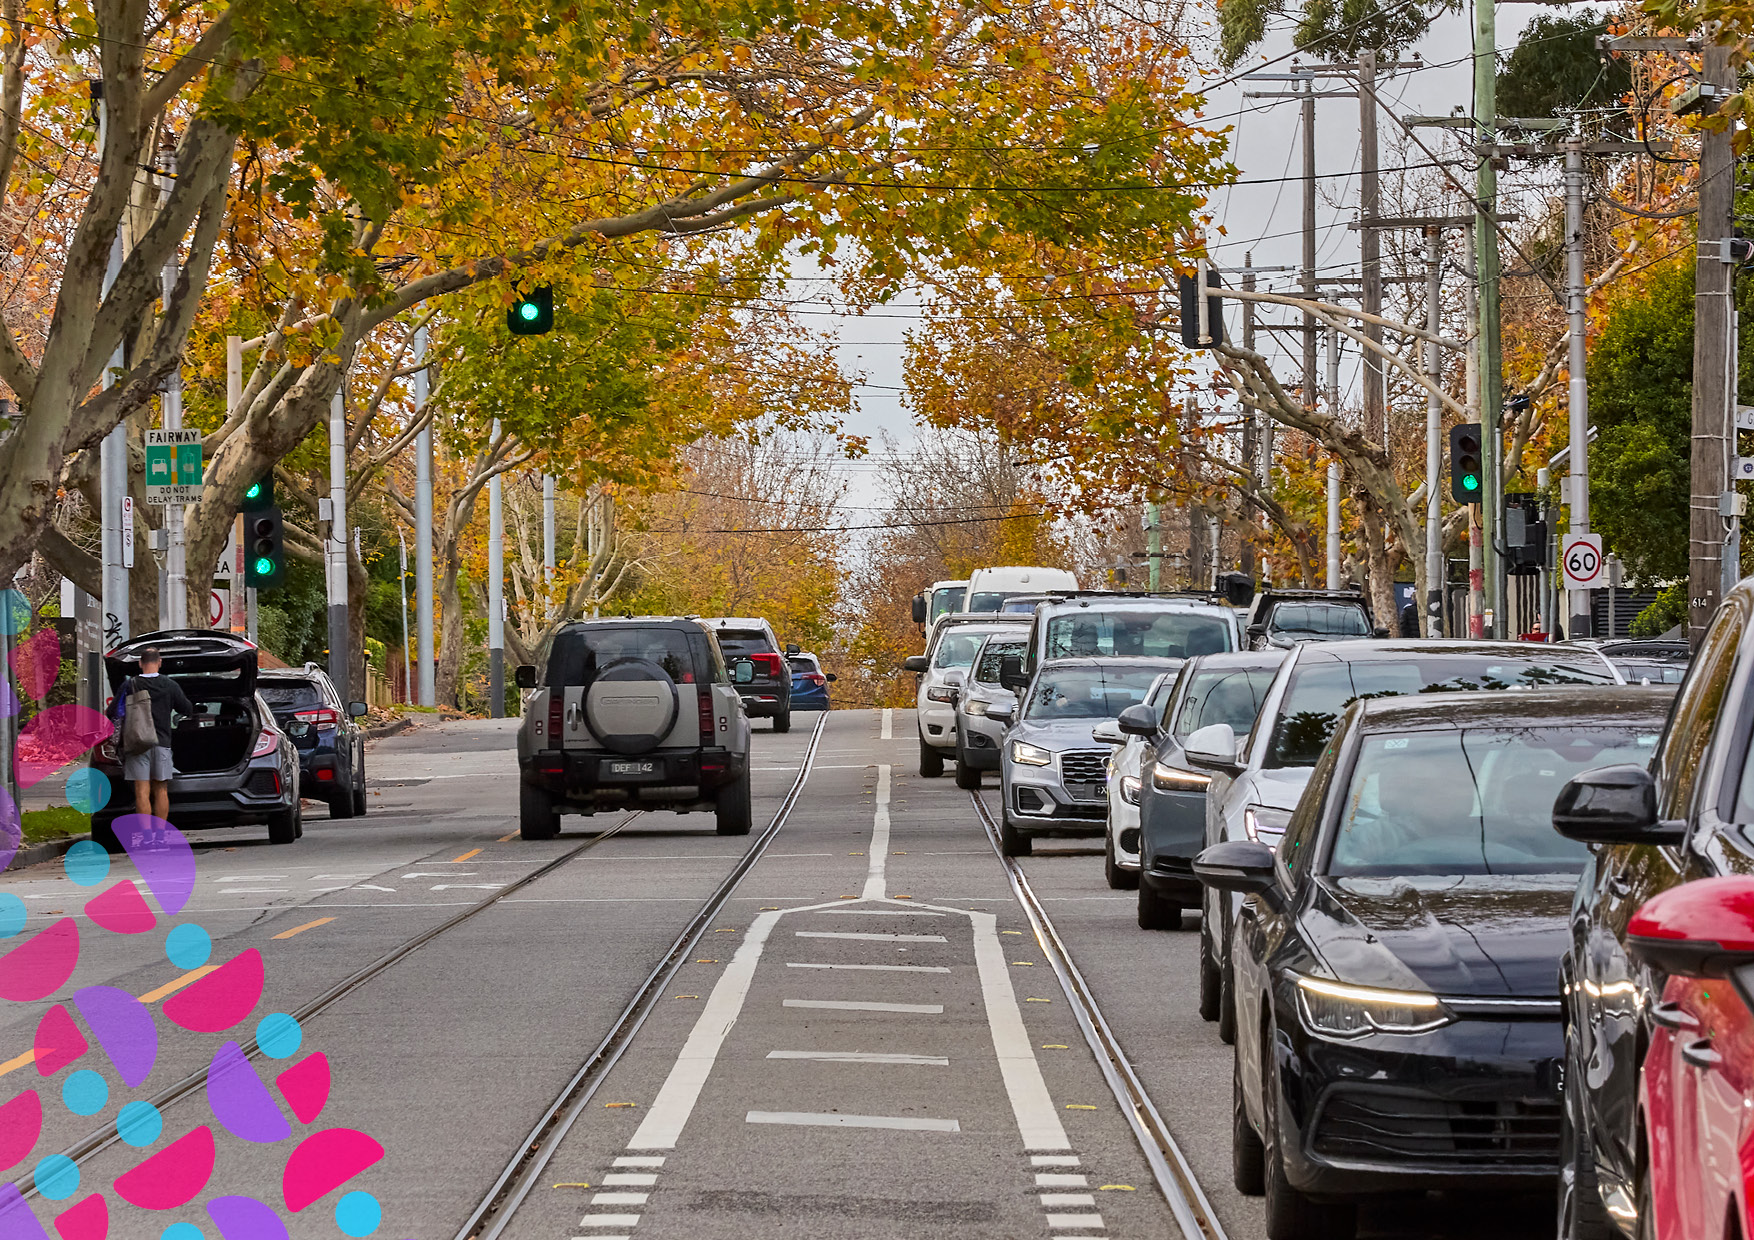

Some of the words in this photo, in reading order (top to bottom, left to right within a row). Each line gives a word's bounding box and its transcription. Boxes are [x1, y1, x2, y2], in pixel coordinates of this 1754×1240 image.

[149, 431, 197, 443] FAIRWAY
[160, 486, 172, 494] DO
[173, 486, 190, 494] NOT
[148, 495, 173, 504] DELAY
[175, 495, 203, 503] TRAMS
[1569, 552, 1596, 572] 60
[1691, 597, 1708, 608] 614
